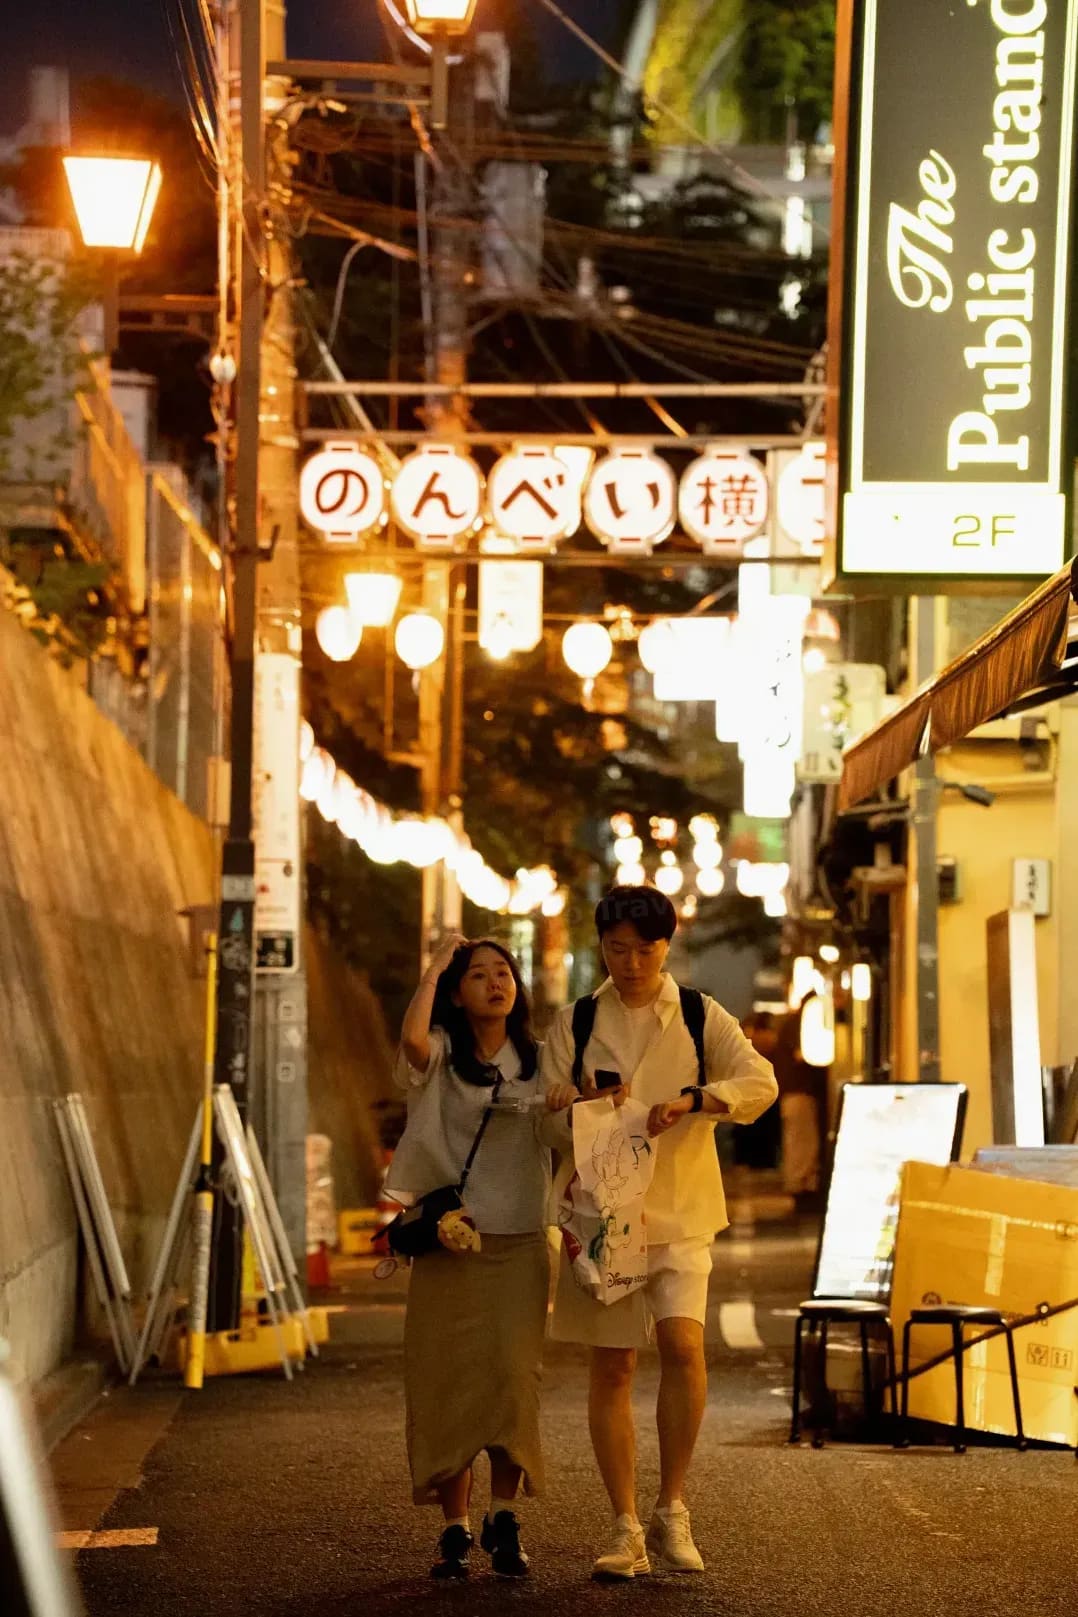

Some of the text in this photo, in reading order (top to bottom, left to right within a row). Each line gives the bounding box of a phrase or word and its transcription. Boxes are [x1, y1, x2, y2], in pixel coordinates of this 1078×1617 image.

[887, 149, 956, 312] The
[947, 228, 1035, 470] Public
[953, 515, 1016, 547] 2F
